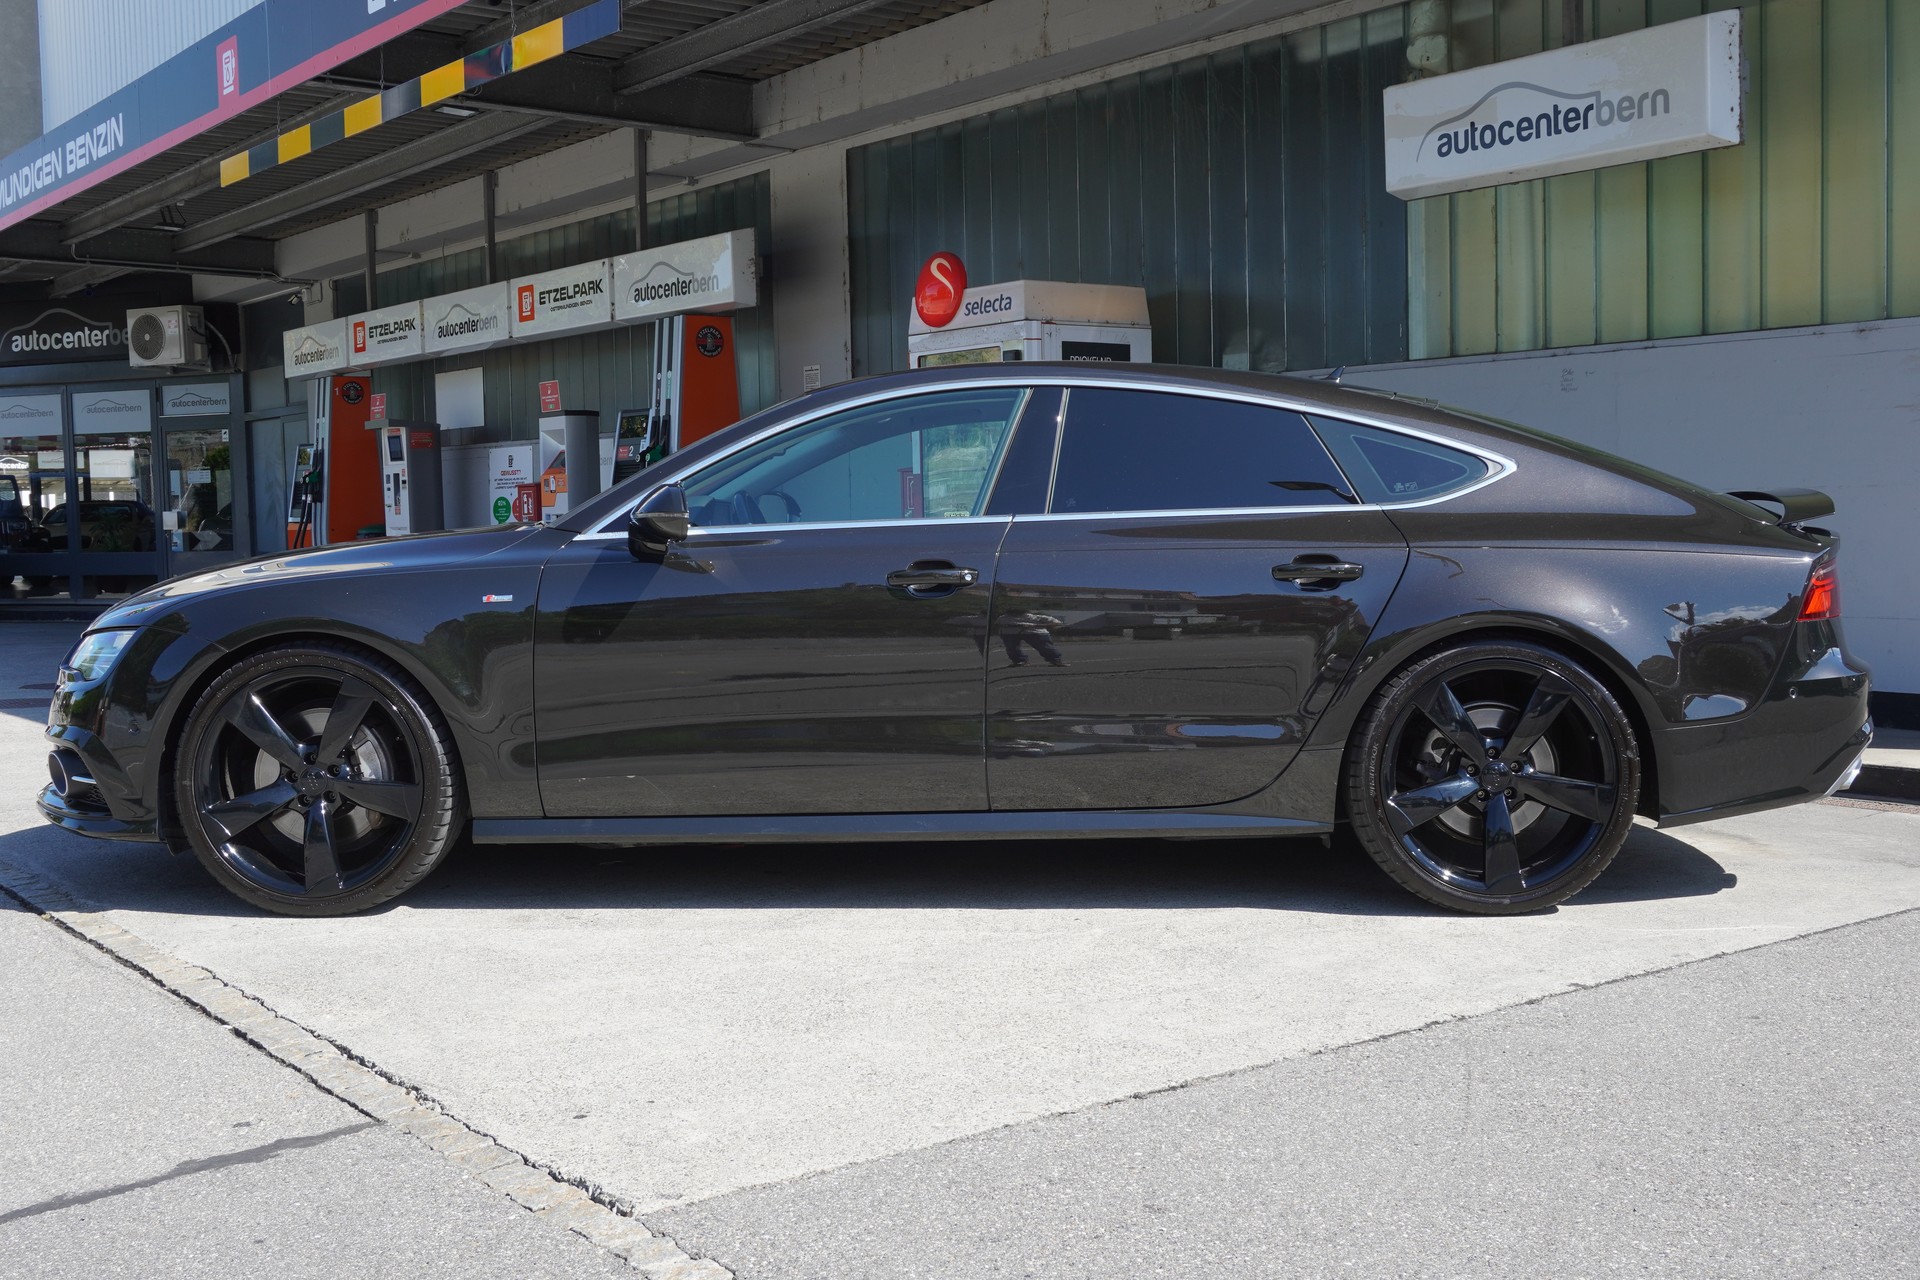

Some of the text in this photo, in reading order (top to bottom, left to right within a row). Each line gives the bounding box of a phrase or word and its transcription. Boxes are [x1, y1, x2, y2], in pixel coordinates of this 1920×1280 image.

[1437, 88, 1670, 158] autocenterbern
[66, 112, 123, 174] BENZIN
[538, 279, 603, 305] ETZELPARK
[634, 274, 719, 303] autocenterbern
[964, 293, 1012, 317] selecta
[368, 318, 416, 339] ETZELPARK
[438, 314, 498, 339] autocenterbern
[294, 346, 339, 366] autocenterbern
[86, 403, 142, 414] autocenterbern
[171, 398, 227, 408] autocenterbern
[628, 445, 634, 457] 2
